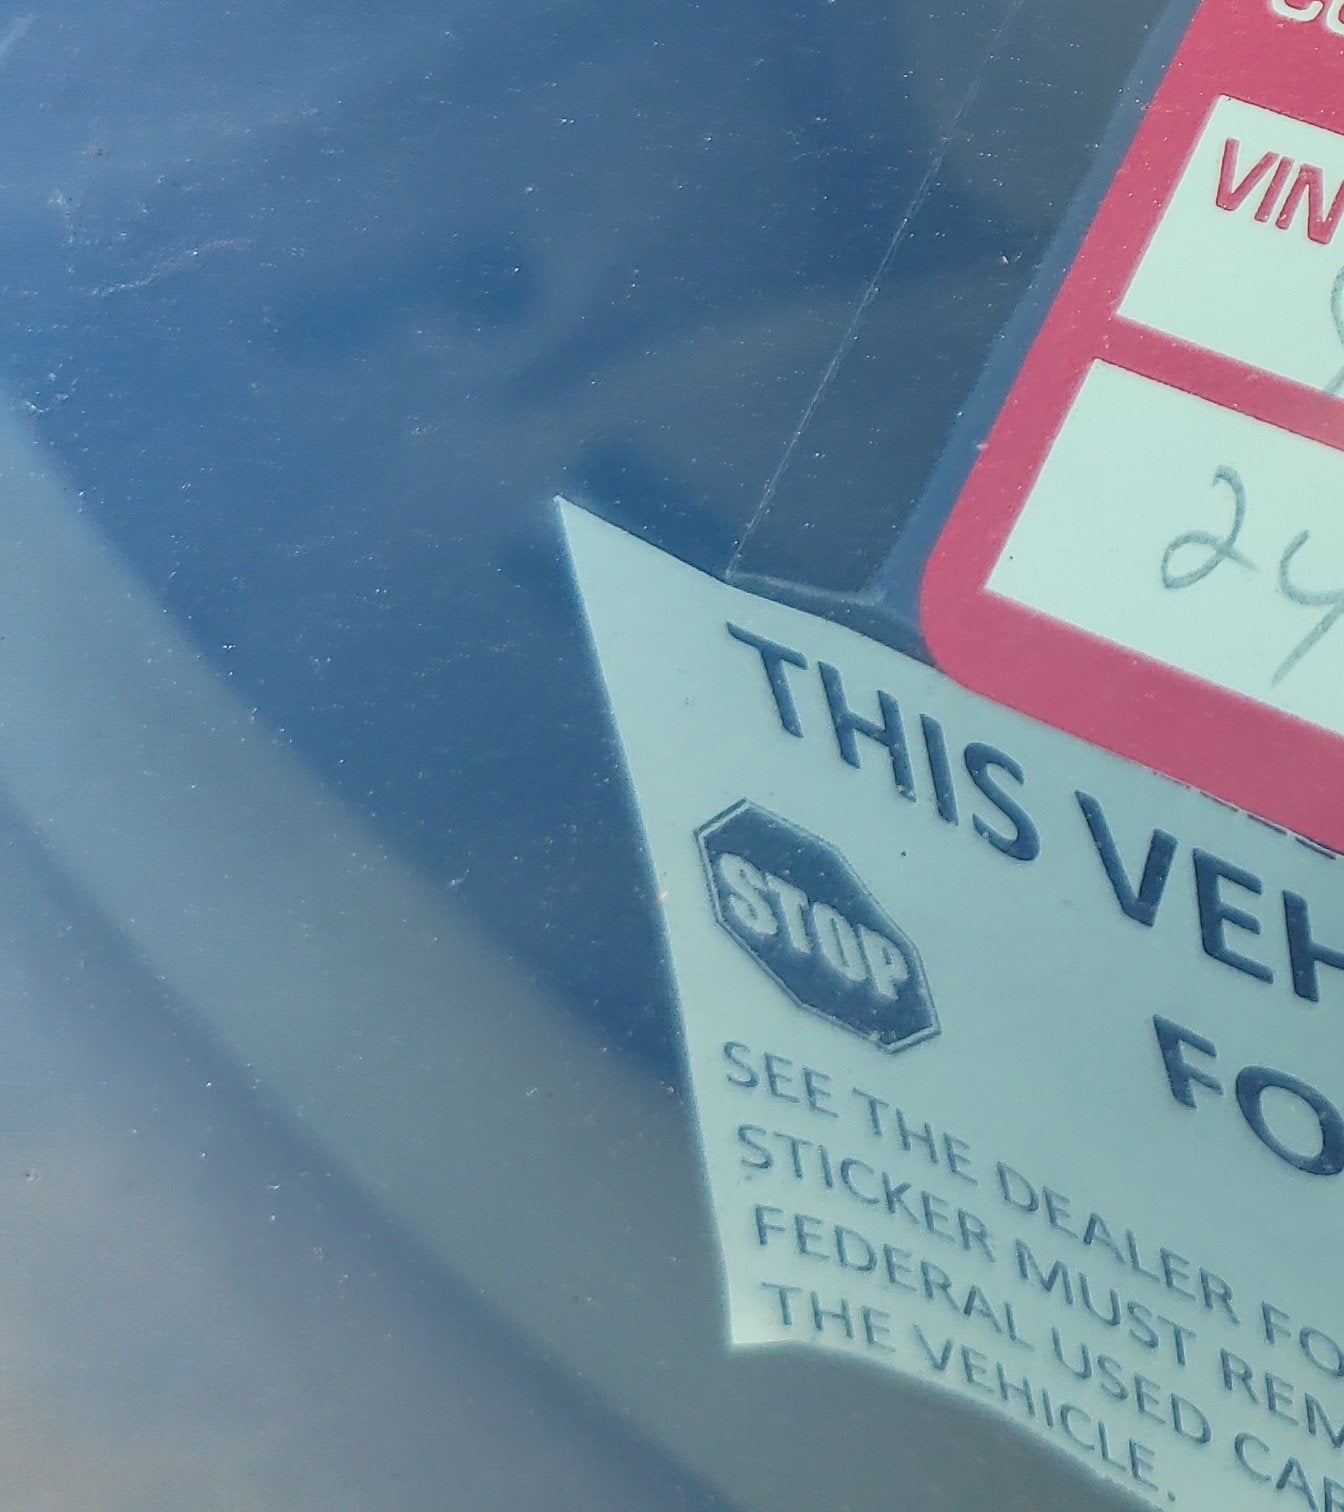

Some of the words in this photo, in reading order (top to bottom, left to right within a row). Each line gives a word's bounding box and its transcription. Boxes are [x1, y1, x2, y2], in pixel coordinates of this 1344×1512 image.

[726, 621, 1041, 862] THIS
[717, 851, 912, 1001] STOP
[722, 1041, 838, 1118] SEE
[852, 1086, 978, 1185] THE
[995, 1160, 1240, 1325] DEALER
[737, 1124, 997, 1262] STICKER
[1015, 1238, 1198, 1365] MUST
[754, 1204, 1035, 1351] FEDERAL
[1051, 1326, 1213, 1445] USED
[760, 1282, 896, 1353] THE
[912, 1323, 1177, 1503] VEHICLE.
